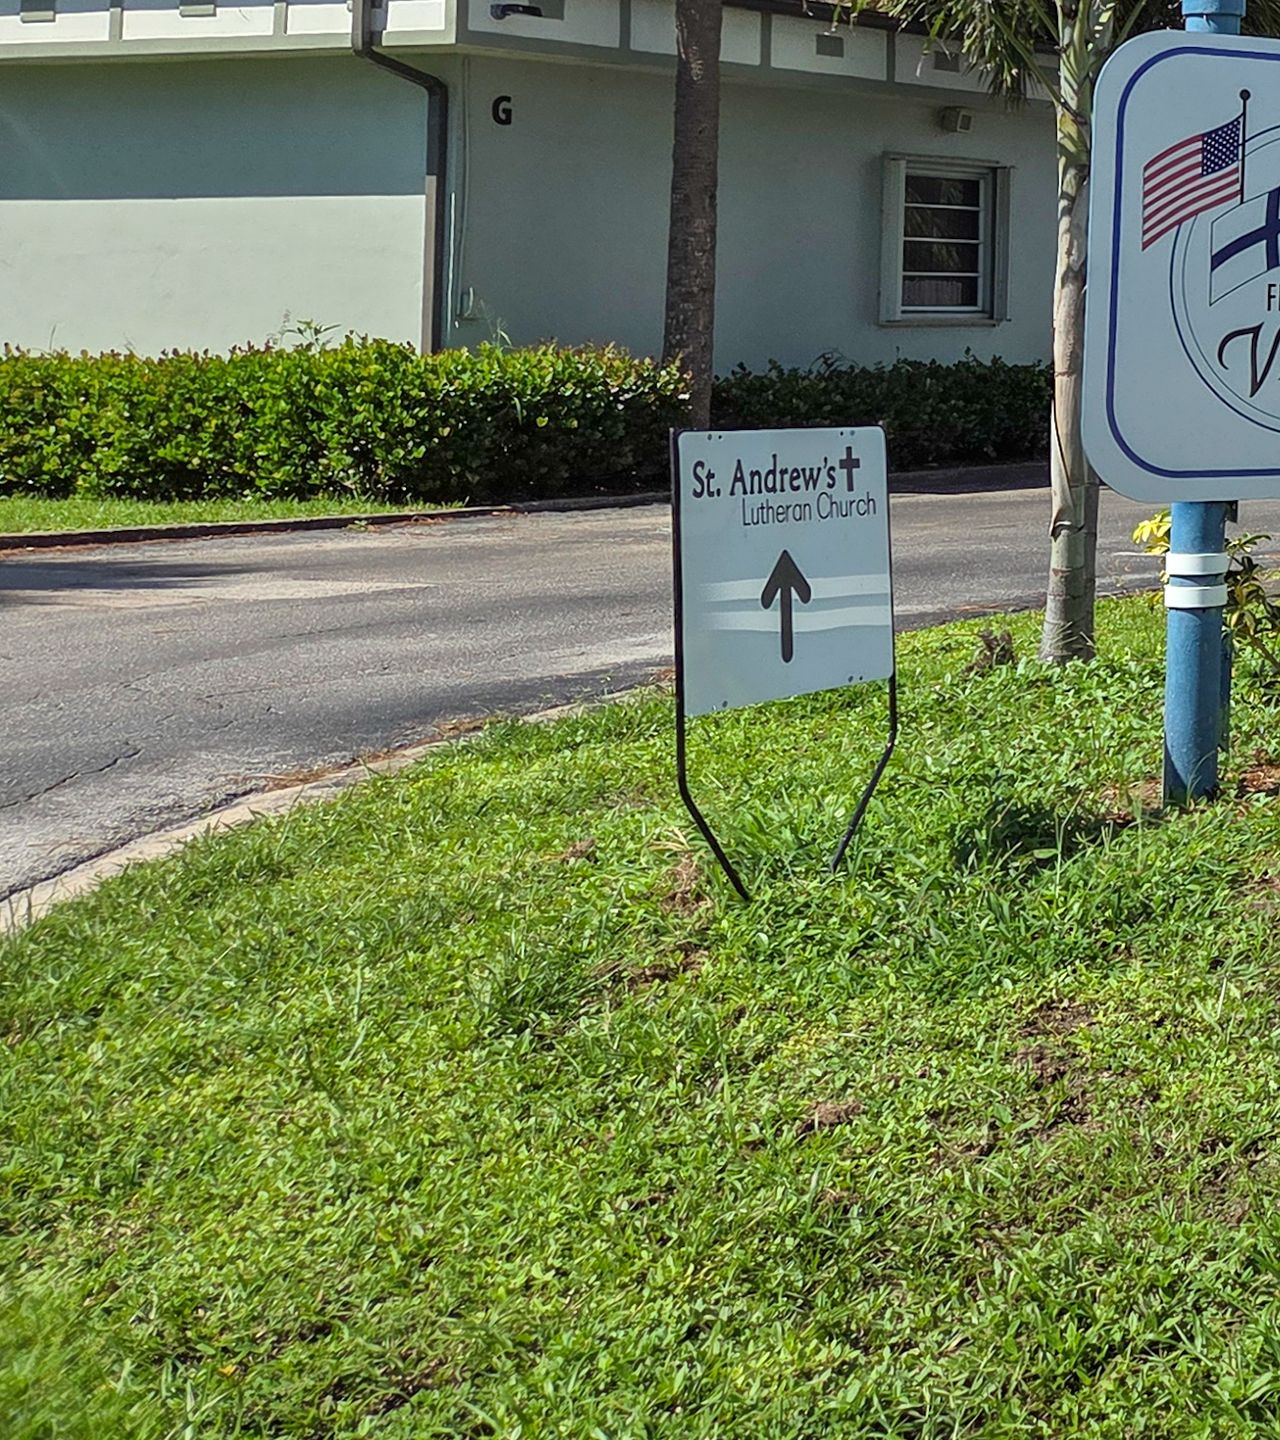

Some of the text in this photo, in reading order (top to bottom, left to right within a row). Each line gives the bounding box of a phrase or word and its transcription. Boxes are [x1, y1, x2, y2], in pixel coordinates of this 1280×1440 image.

[492, 95, 512, 125] G
[692, 453, 837, 498] St. Andrew's
[742, 491, 877, 526] Lutheran Church
